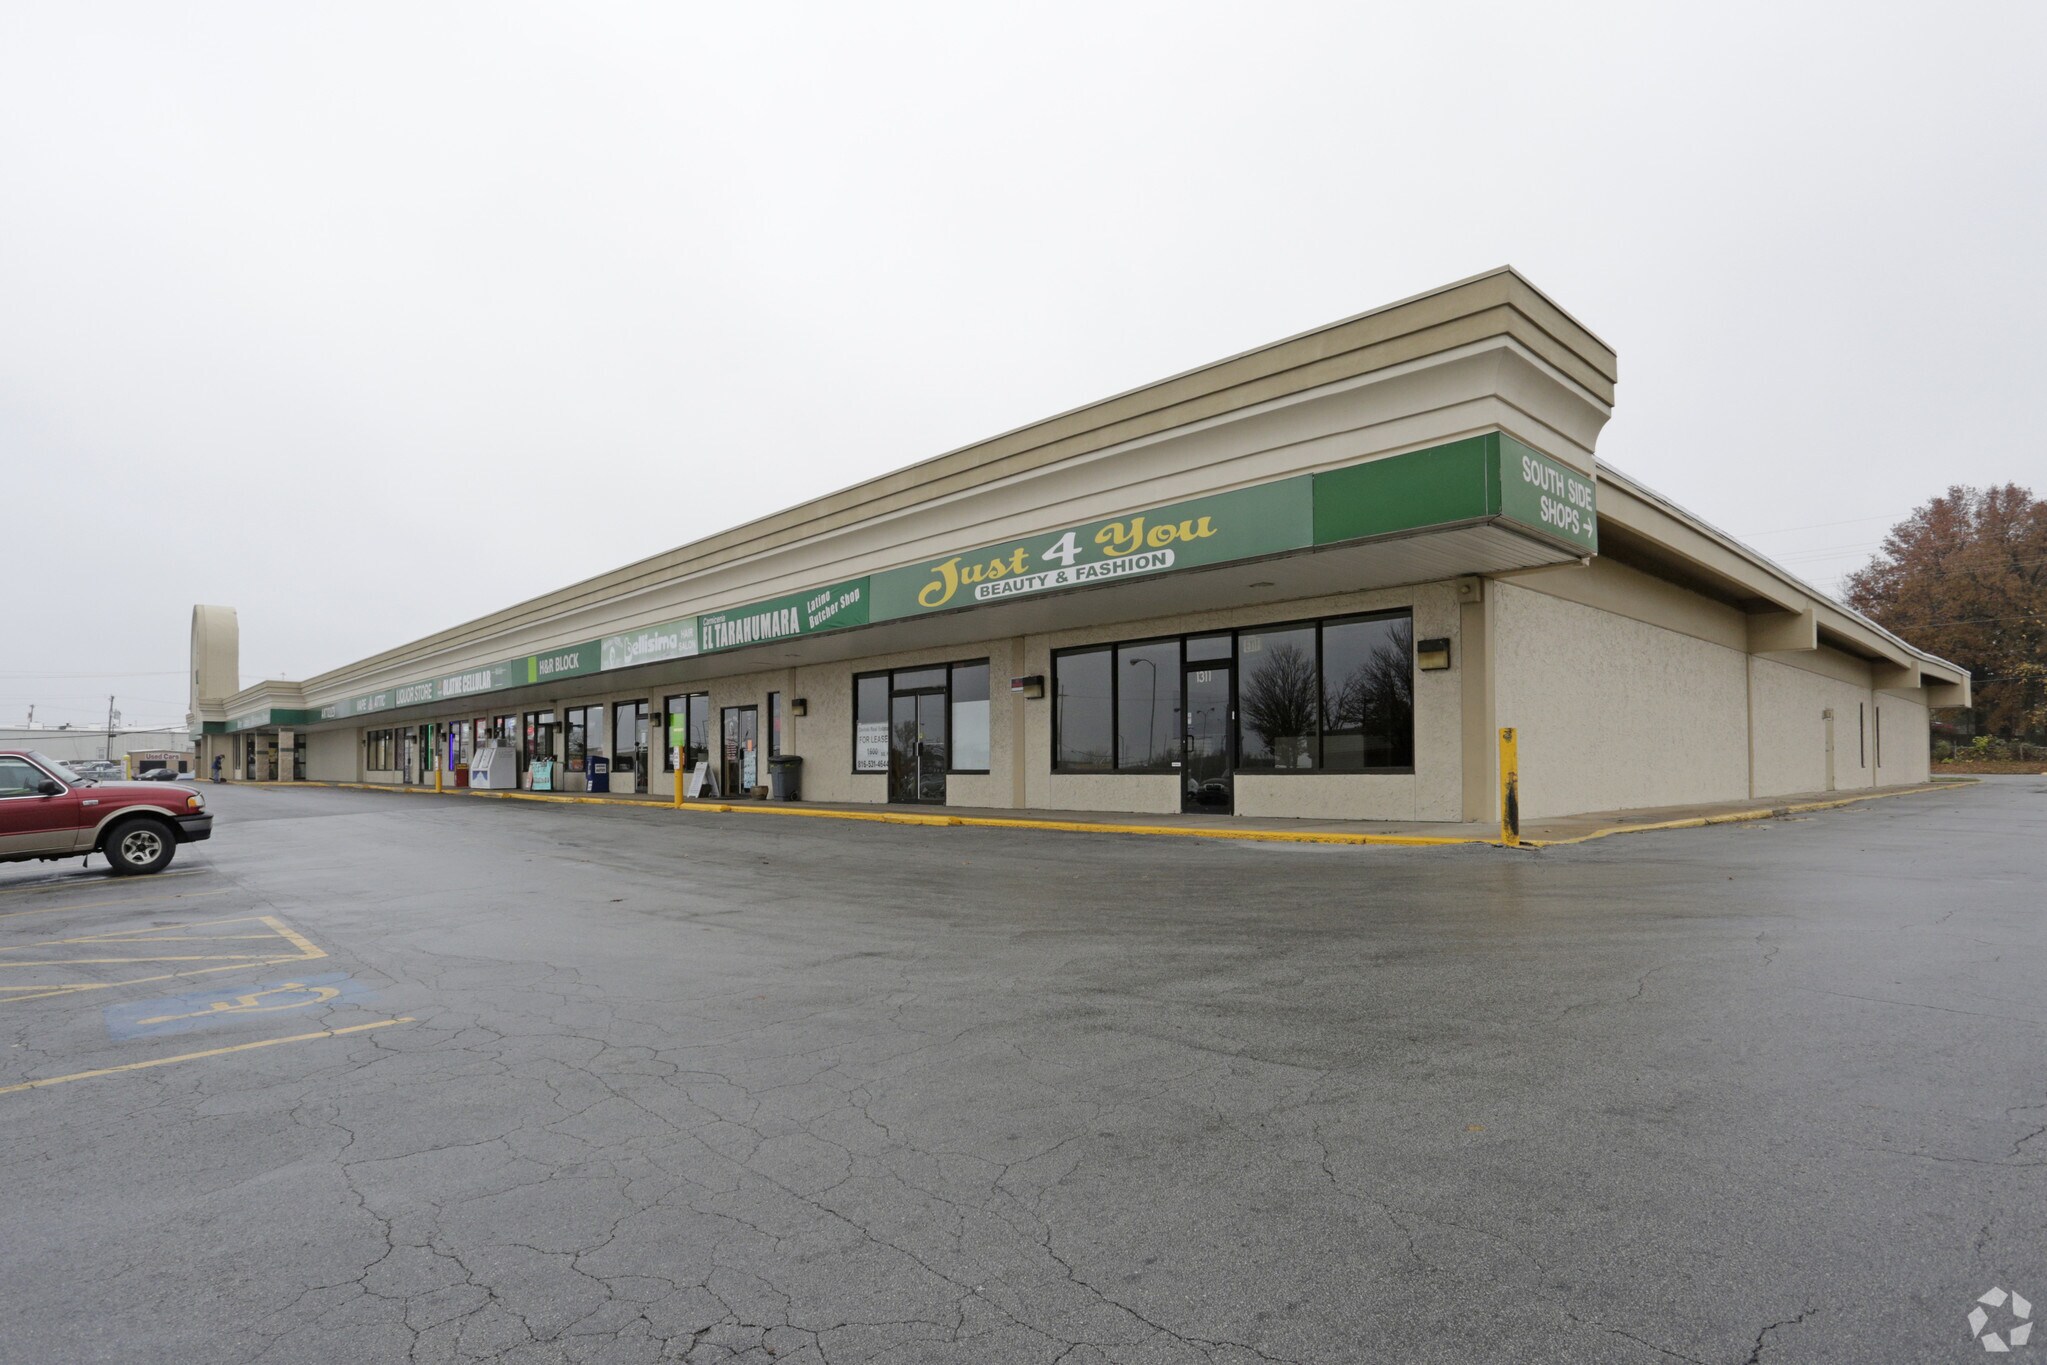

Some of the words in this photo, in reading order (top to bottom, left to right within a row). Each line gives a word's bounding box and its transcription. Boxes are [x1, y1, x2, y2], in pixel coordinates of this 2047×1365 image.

[1522, 455, 1565, 498] SOUTH
[1567, 478, 1593, 512] SIDE
[1540, 495, 1580, 534] SHOPS
[918, 547, 1029, 608] Just
[1041, 531, 1083, 566] 4
[1094, 516, 1217, 557] You
[979, 573, 1049, 599] BEAUTY
[1055, 572, 1069, 584] &
[1075, 552, 1167, 580] FASHION
[806, 590, 831, 614] Latino
[808, 601, 839, 629] Butcher
[840, 588, 860, 609] Shop
[680, 627, 694, 639] HAIR
[703, 625, 714, 650] EL
[714, 606, 800, 648] TARAHUMARA
[678, 639, 696, 651] SALON
[539, 657, 554, 675] H&R
[555, 652, 579, 672] BLOCK
[462, 670, 491, 693] CELLULAR
[1196, 670, 1212, 683] 1311
[396, 686, 414, 704] LIQUOR
[414, 682, 432, 701] STORE
[871, 735, 888, 743] LEASE
